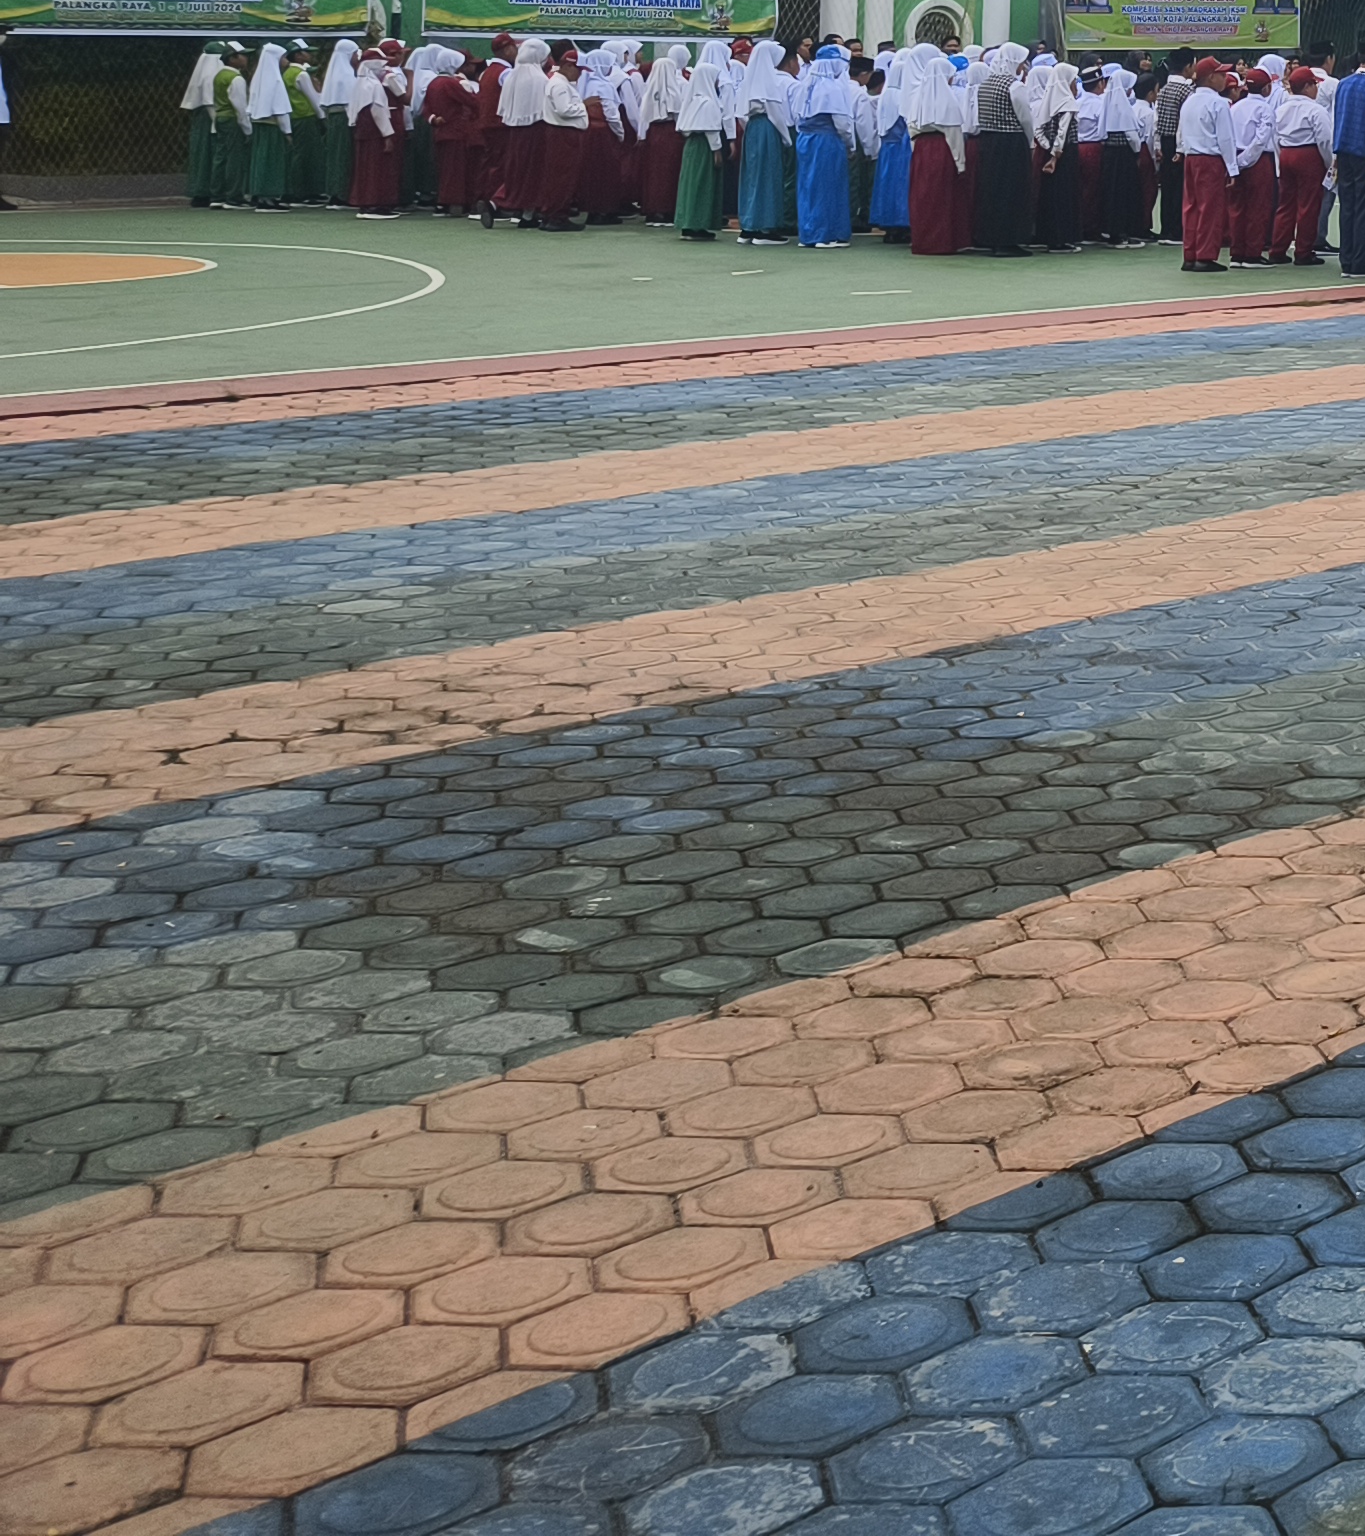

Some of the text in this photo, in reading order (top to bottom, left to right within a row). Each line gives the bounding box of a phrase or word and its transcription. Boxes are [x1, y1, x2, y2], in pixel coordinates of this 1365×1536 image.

[54, 1, 117, 10] PALANGKA
[188, 3, 211, 12] JULI
[215, 3, 242, 13] 2024
[539, 7, 584, 15] PALANGKA
[1130, 15, 1161, 23] TINGKAT
[1163, 15, 1183, 23] KOTA
[1184, 15, 1221, 23] PALANGKA
